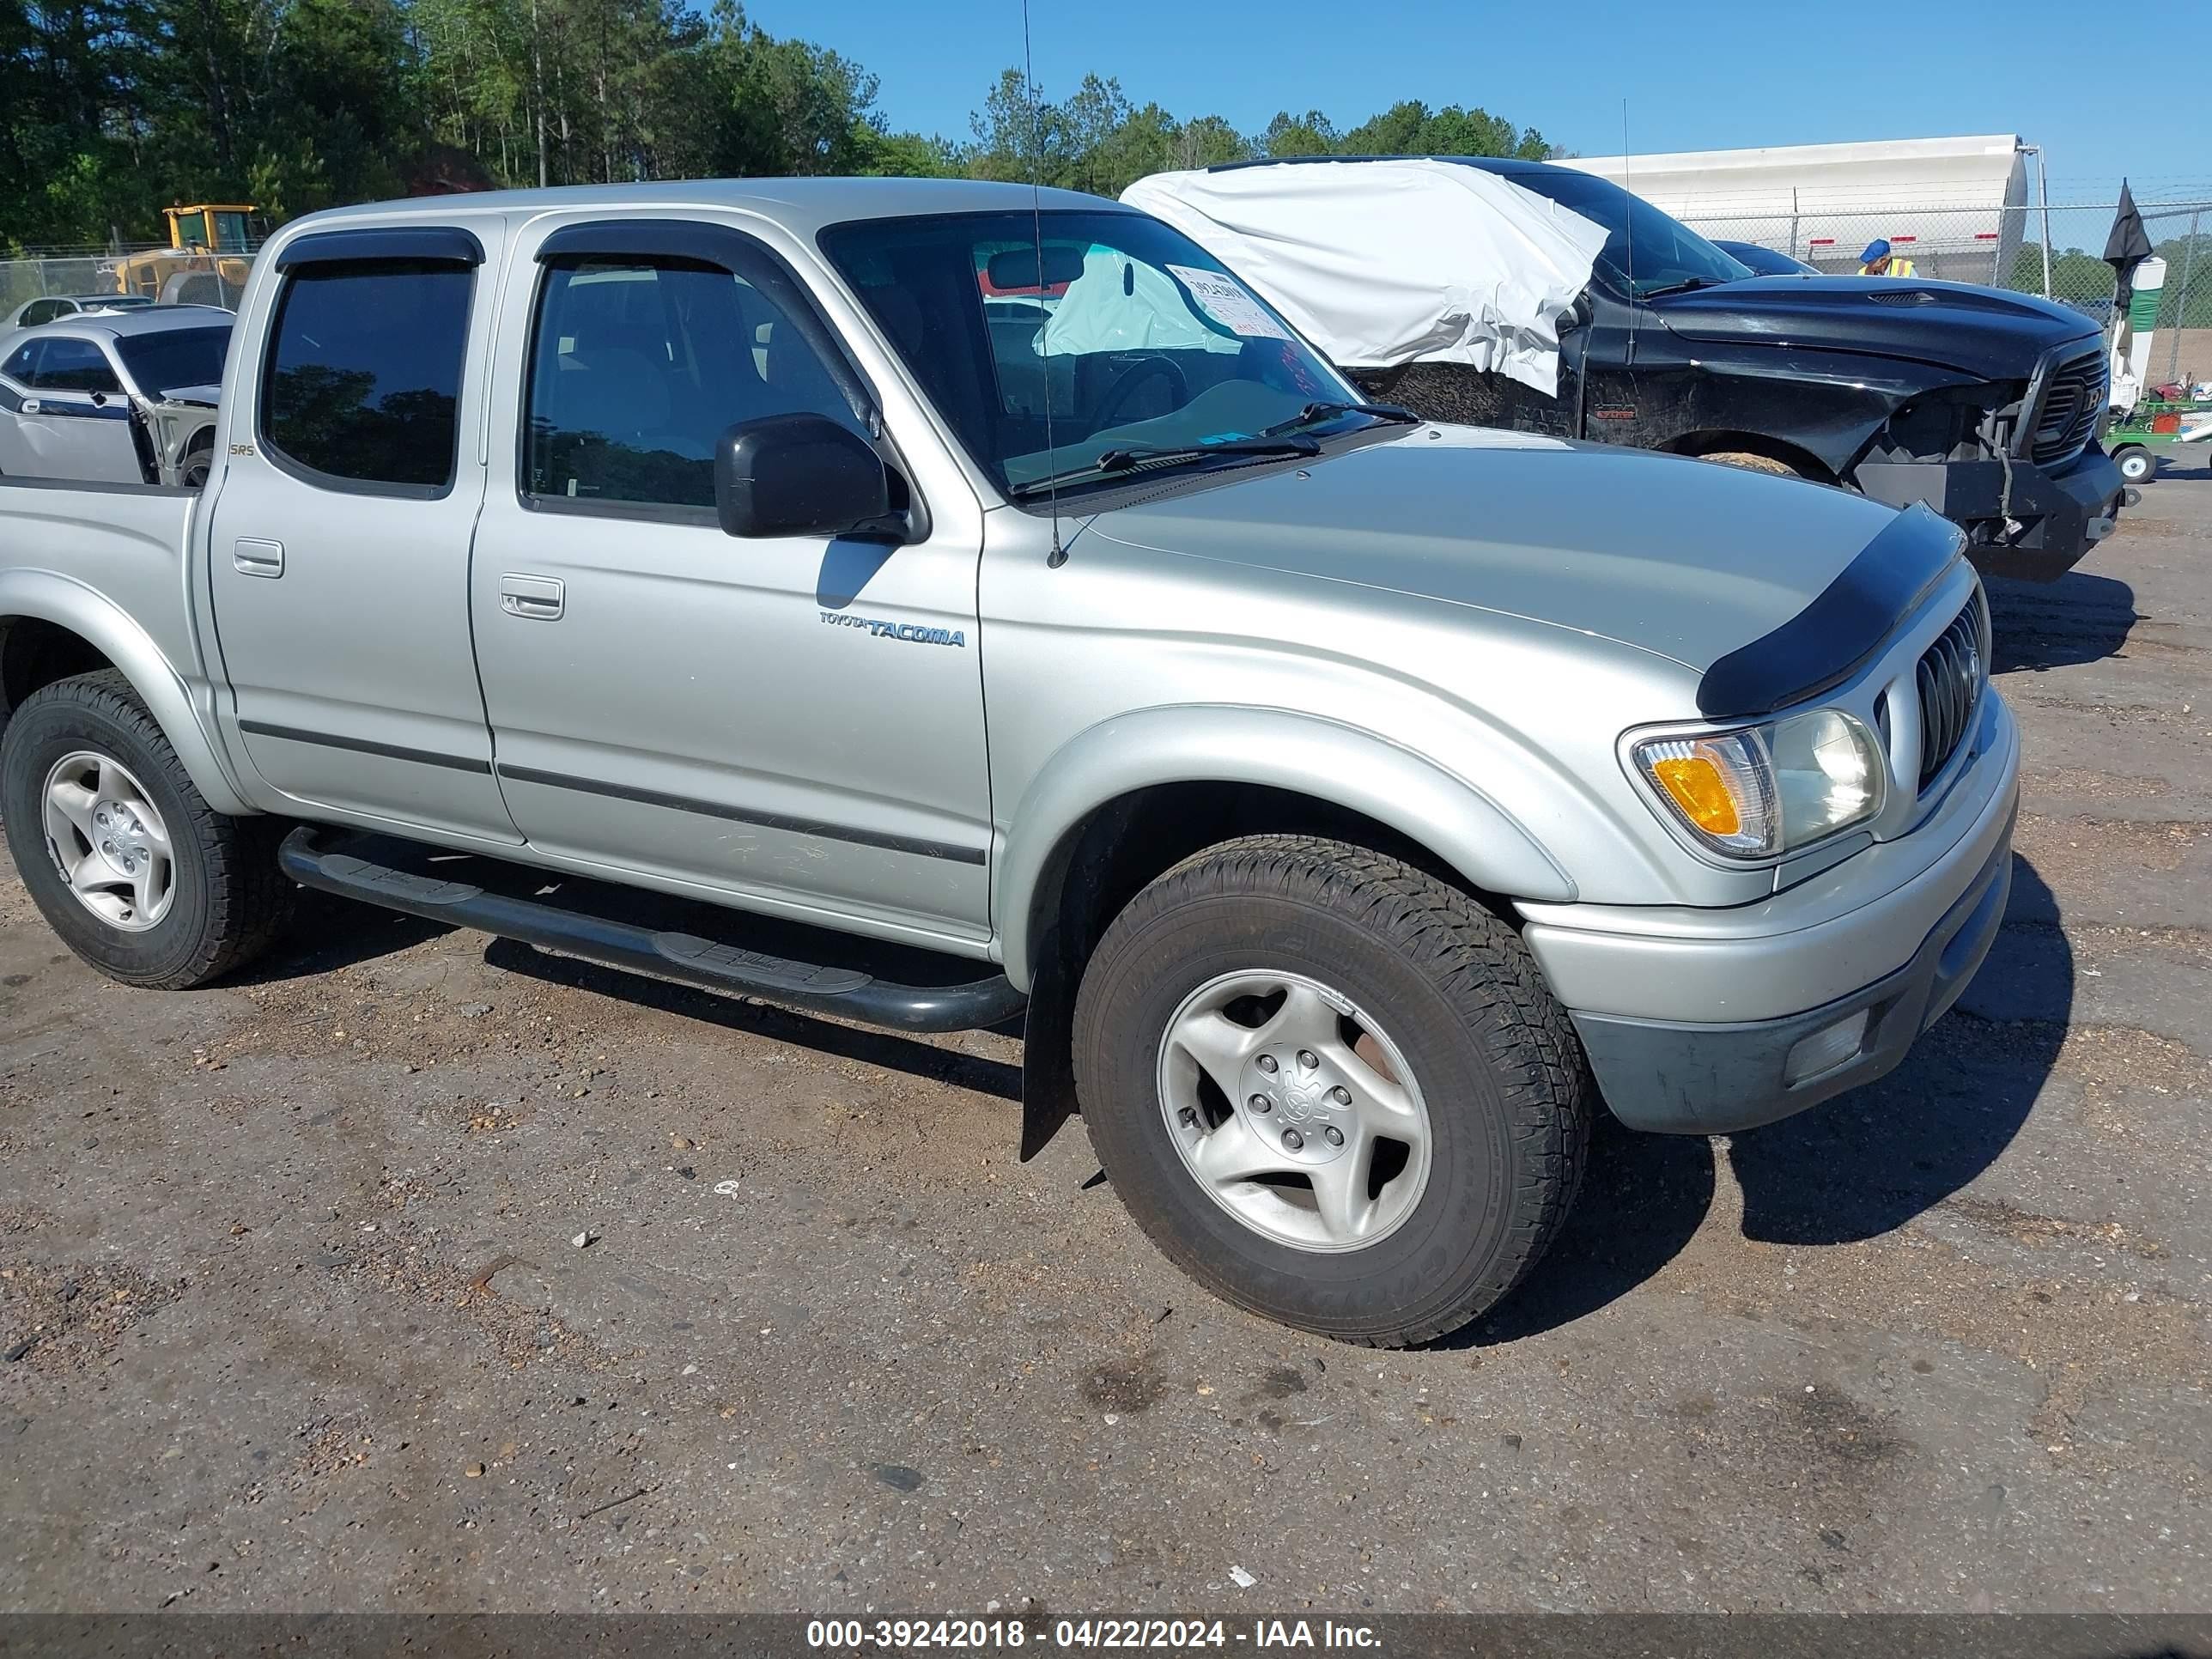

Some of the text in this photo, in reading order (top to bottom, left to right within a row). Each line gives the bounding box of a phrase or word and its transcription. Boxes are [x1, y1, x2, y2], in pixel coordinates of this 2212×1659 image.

[230, 444, 255, 457] SRS
[819, 611, 966, 647] TOYOTA TACOMA
